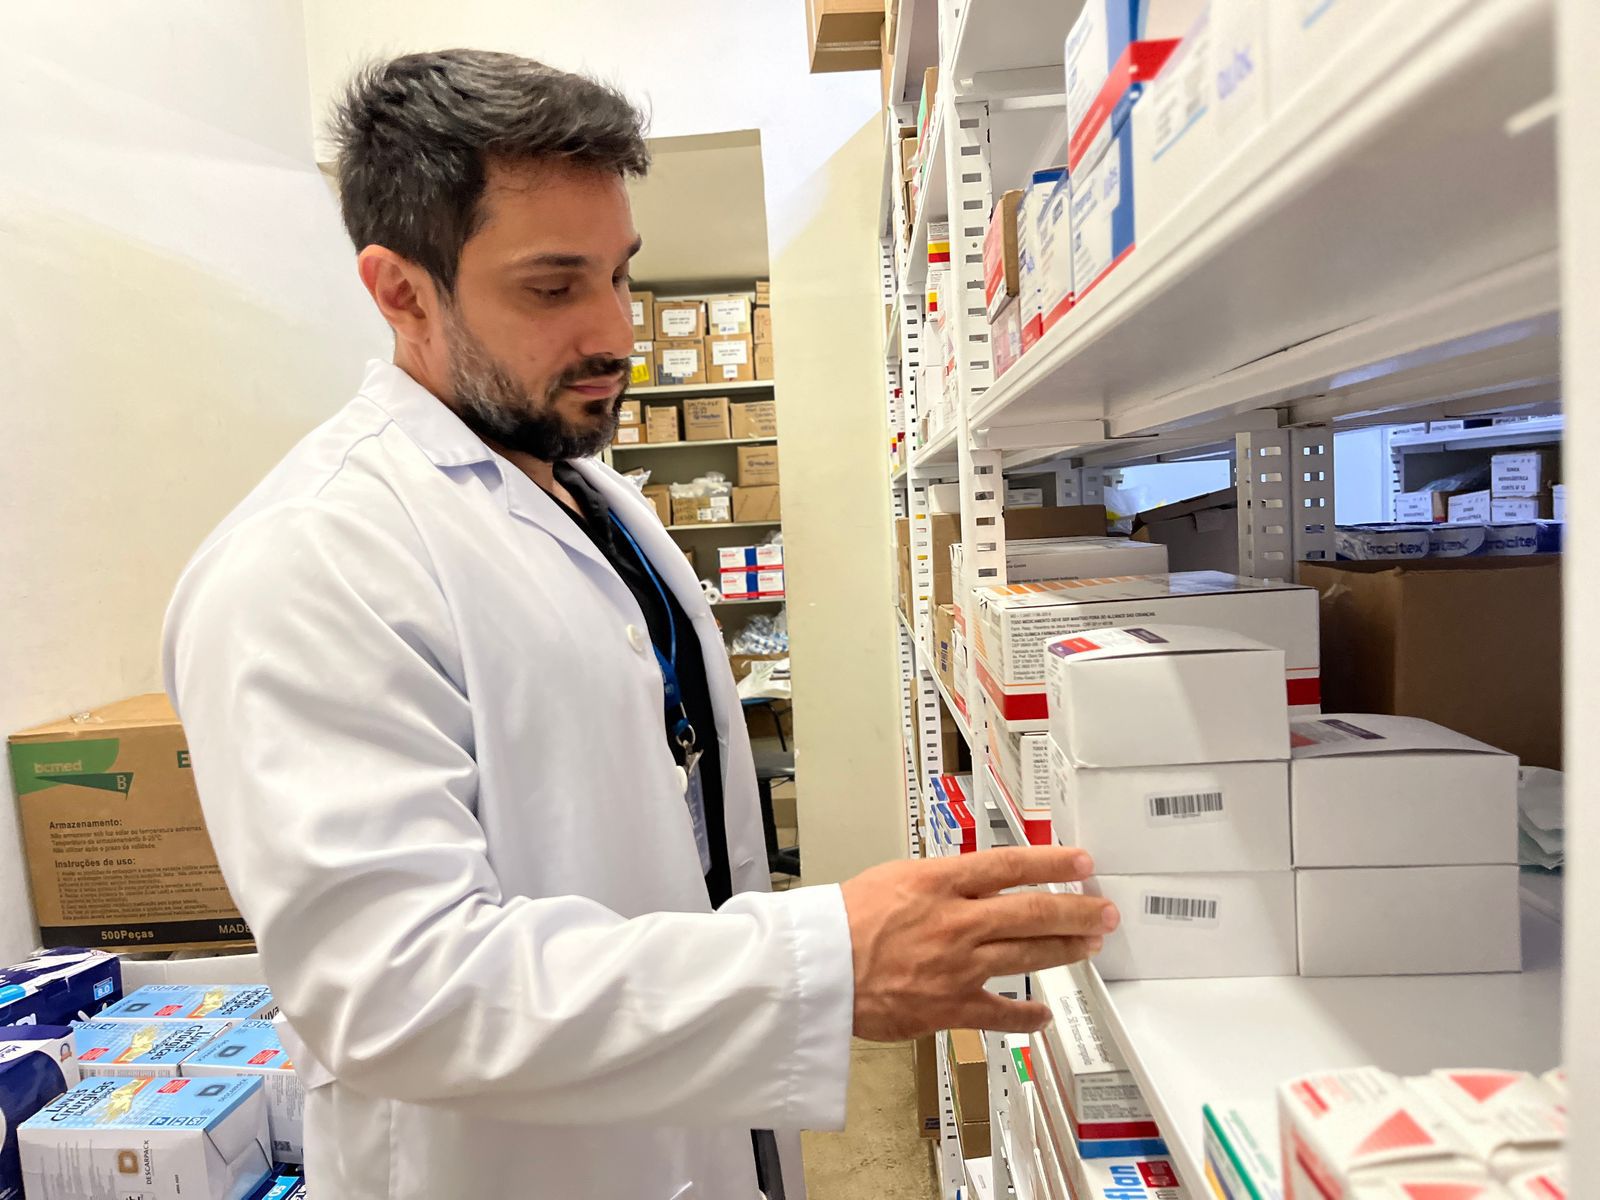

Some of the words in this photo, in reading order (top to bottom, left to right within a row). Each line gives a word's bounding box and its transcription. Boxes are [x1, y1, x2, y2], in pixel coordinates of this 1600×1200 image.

[49, 818, 123, 830] Armazenamento:
[55, 859, 100, 869] Instruções
[103, 858, 114, 867] de
[116, 857, 137, 867] uso:
[101, 929, 154, 941] 500Peças
[174, 1030, 211, 1053] Luvas
[45, 1088, 88, 1114] Luvas
[50, 1081, 115, 1122] Cirúrgicas
[143, 1139, 152, 1185] DESCARPACK
